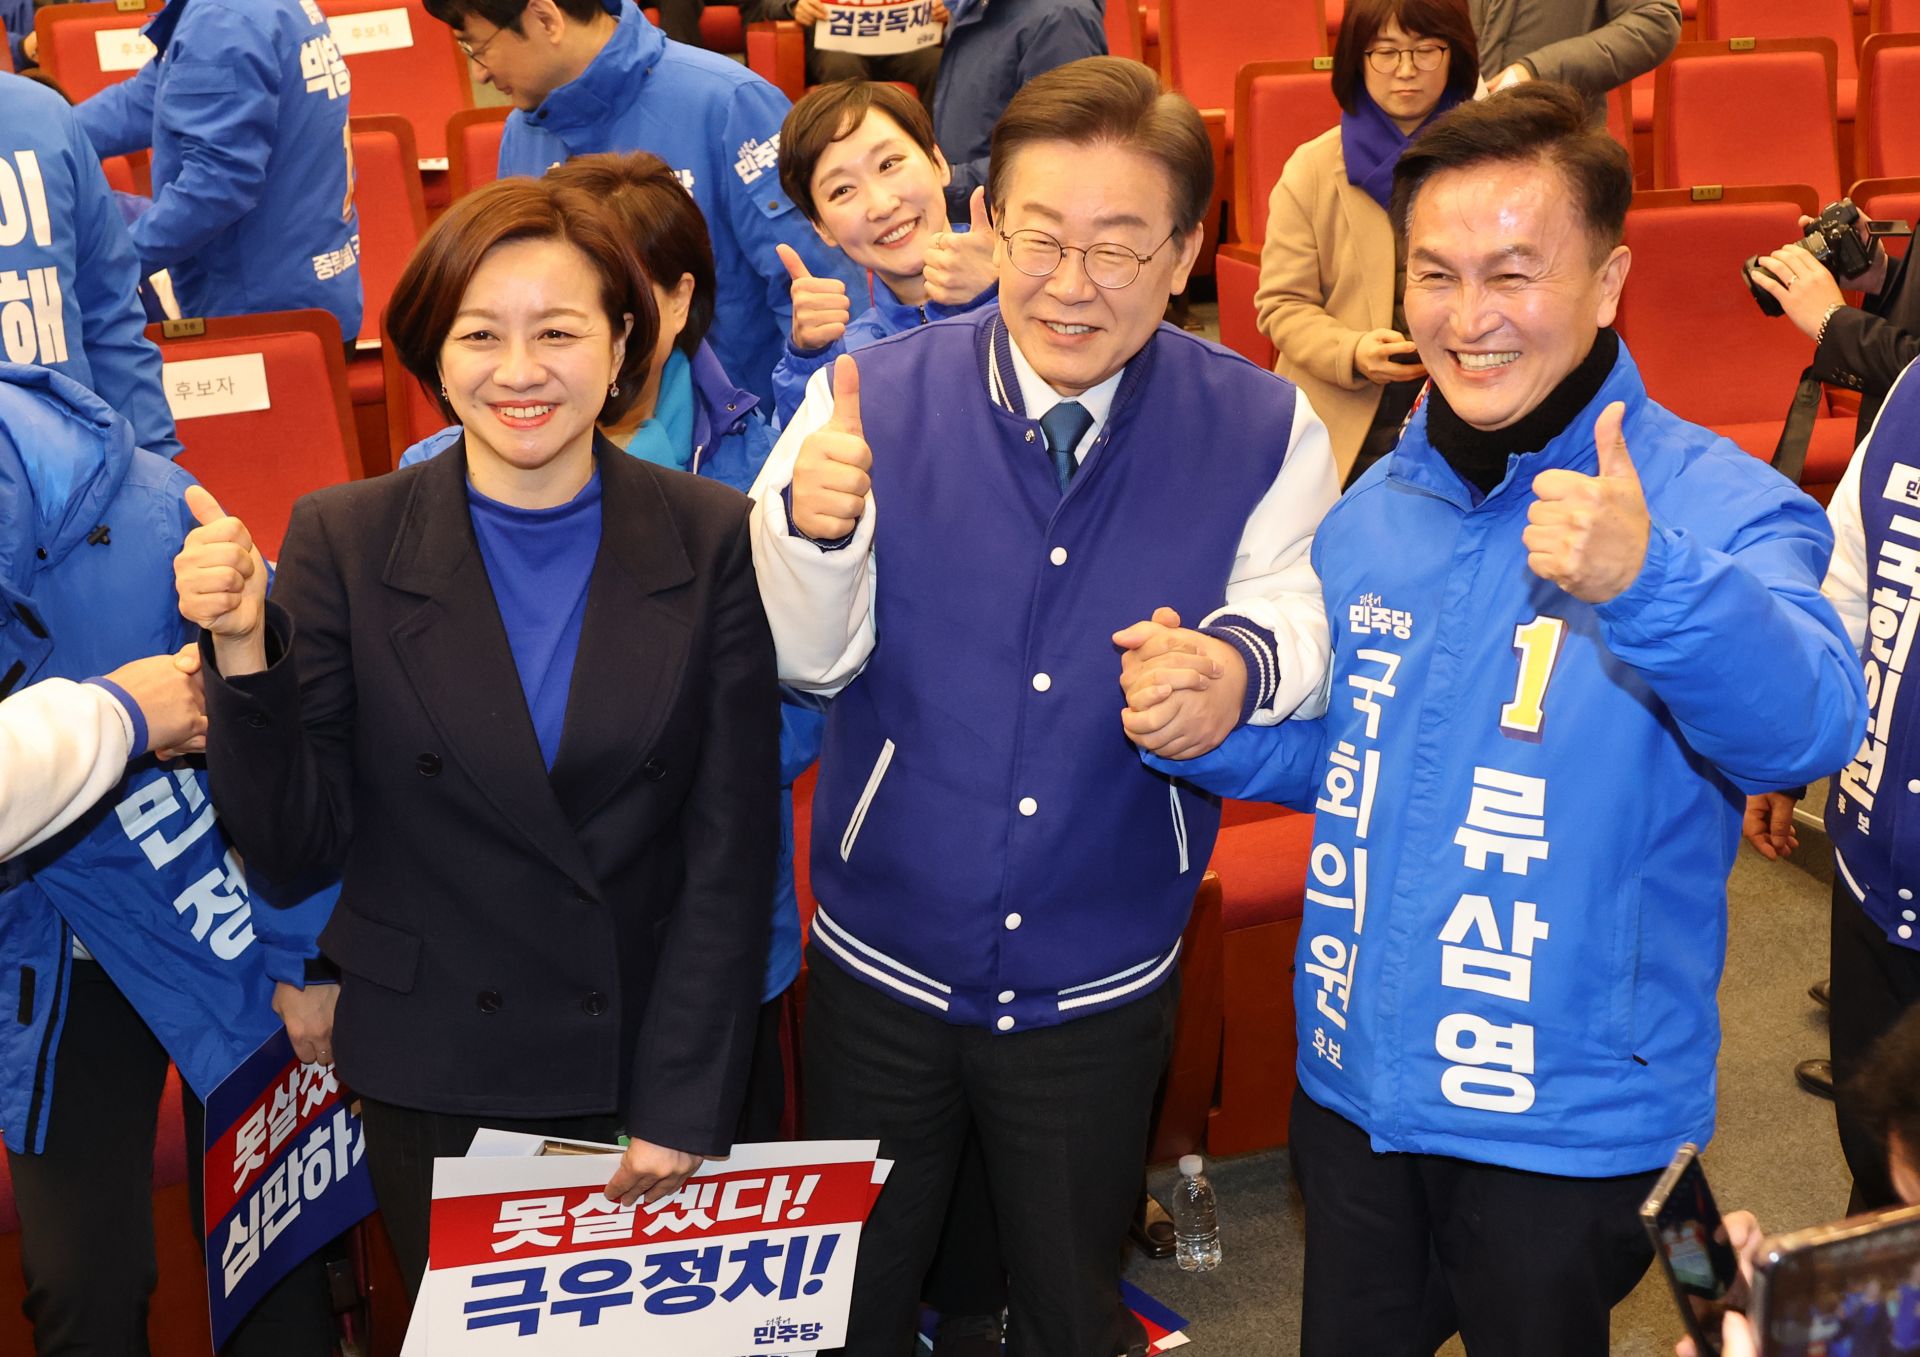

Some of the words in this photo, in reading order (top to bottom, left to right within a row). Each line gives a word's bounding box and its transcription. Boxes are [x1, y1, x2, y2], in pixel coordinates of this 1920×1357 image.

[829, 1, 932, 37] 검찰독재
[175, 376, 236, 401] 후보자
[1349, 604, 1413, 640] 민주당
[1500, 614, 1568, 745] 1
[1305, 648, 1402, 1031] 국회의원
[1434, 766, 1550, 1114] 류삼영
[1312, 1027, 1343, 1071] 후보
[490, 1173, 822, 1255] 못살겠다!
[463, 1232, 842, 1337] 극우정치!
[753, 1322, 824, 1345] 민주당
